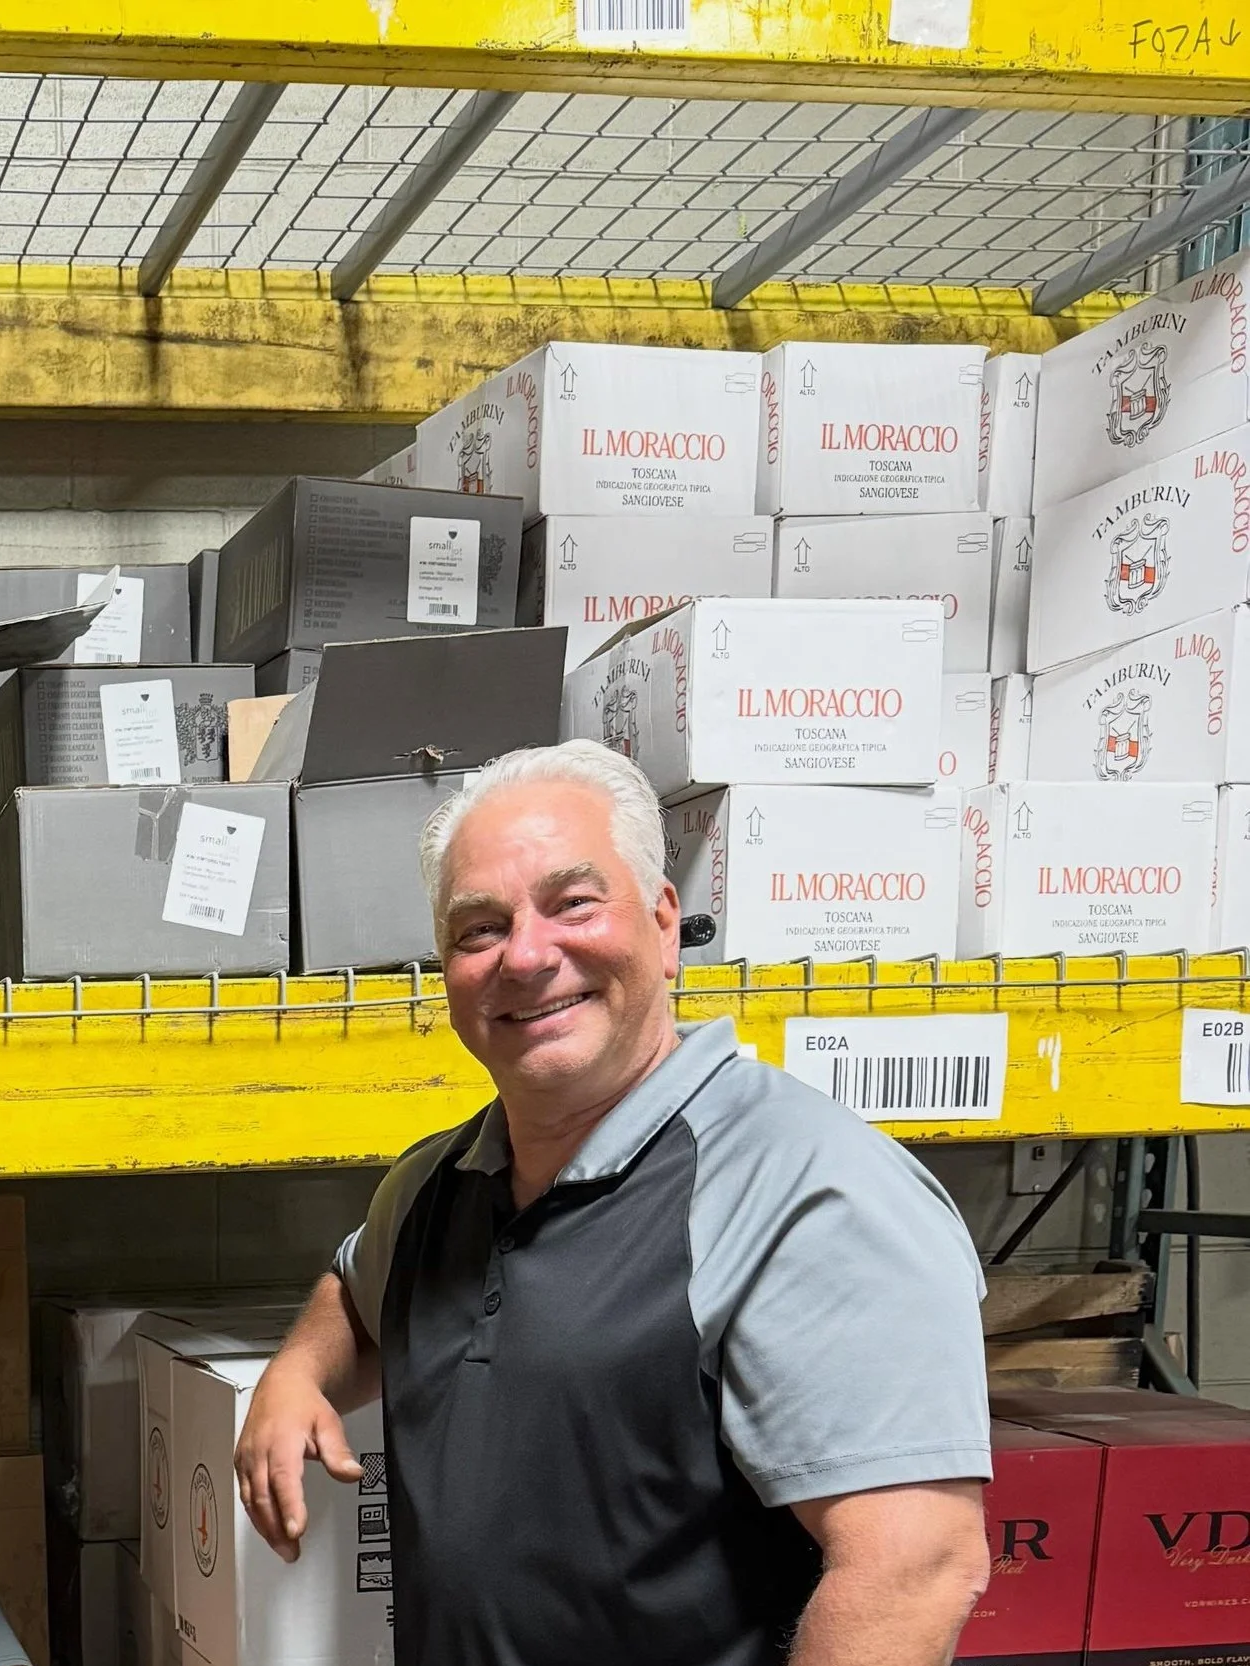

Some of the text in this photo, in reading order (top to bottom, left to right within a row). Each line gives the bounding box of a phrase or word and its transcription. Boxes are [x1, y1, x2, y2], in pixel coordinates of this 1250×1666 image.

[1209, 272, 1247, 374] MORACCIO
[1092, 312, 1187, 377] TAMBURINI
[448, 404, 505, 453] TAMBURINI
[821, 423, 959, 453] IL MORACCIO
[582, 429, 725, 461] IL MORACCIO
[632, 468, 677, 481] TOSCANA
[869, 460, 912, 472] TOSCANA
[595, 480, 711, 493] INDICAZIONE GEOGRAFICA TIPICA
[859, 488, 919, 499] SANGIOVESE
[622, 495, 684, 508] SANGIOVESE
[1211, 450, 1250, 553] MORACCIO
[1092, 485, 1190, 541] TAMBURINI
[592, 658, 650, 708] TAMBURINI
[1082, 663, 1171, 711] TAMBURINI
[1175, 633, 1225, 736] IL MORACCIO
[738, 688, 903, 718] IL MORACCIO
[795, 728, 847, 740] TOSCANA
[754, 743, 859, 752] INDICAZIONE GEOGRAFICA
[784, 757, 856, 769] SANGIOVESE
[770, 873, 925, 901] IL MORACCIO
[1038, 866, 1182, 895] IL MORACCIO
[824, 911, 873, 923] TOSCANA
[1088, 904, 1133, 916] TOSCANA
[814, 940, 881, 952] SANGIOVESE
[1078, 932, 1139, 944] SANGIOVESE
[1202, 1022, 1244, 1038] E02B
[806, 1036, 849, 1051] E02A
[1143, 1510, 1250, 1552] VD
